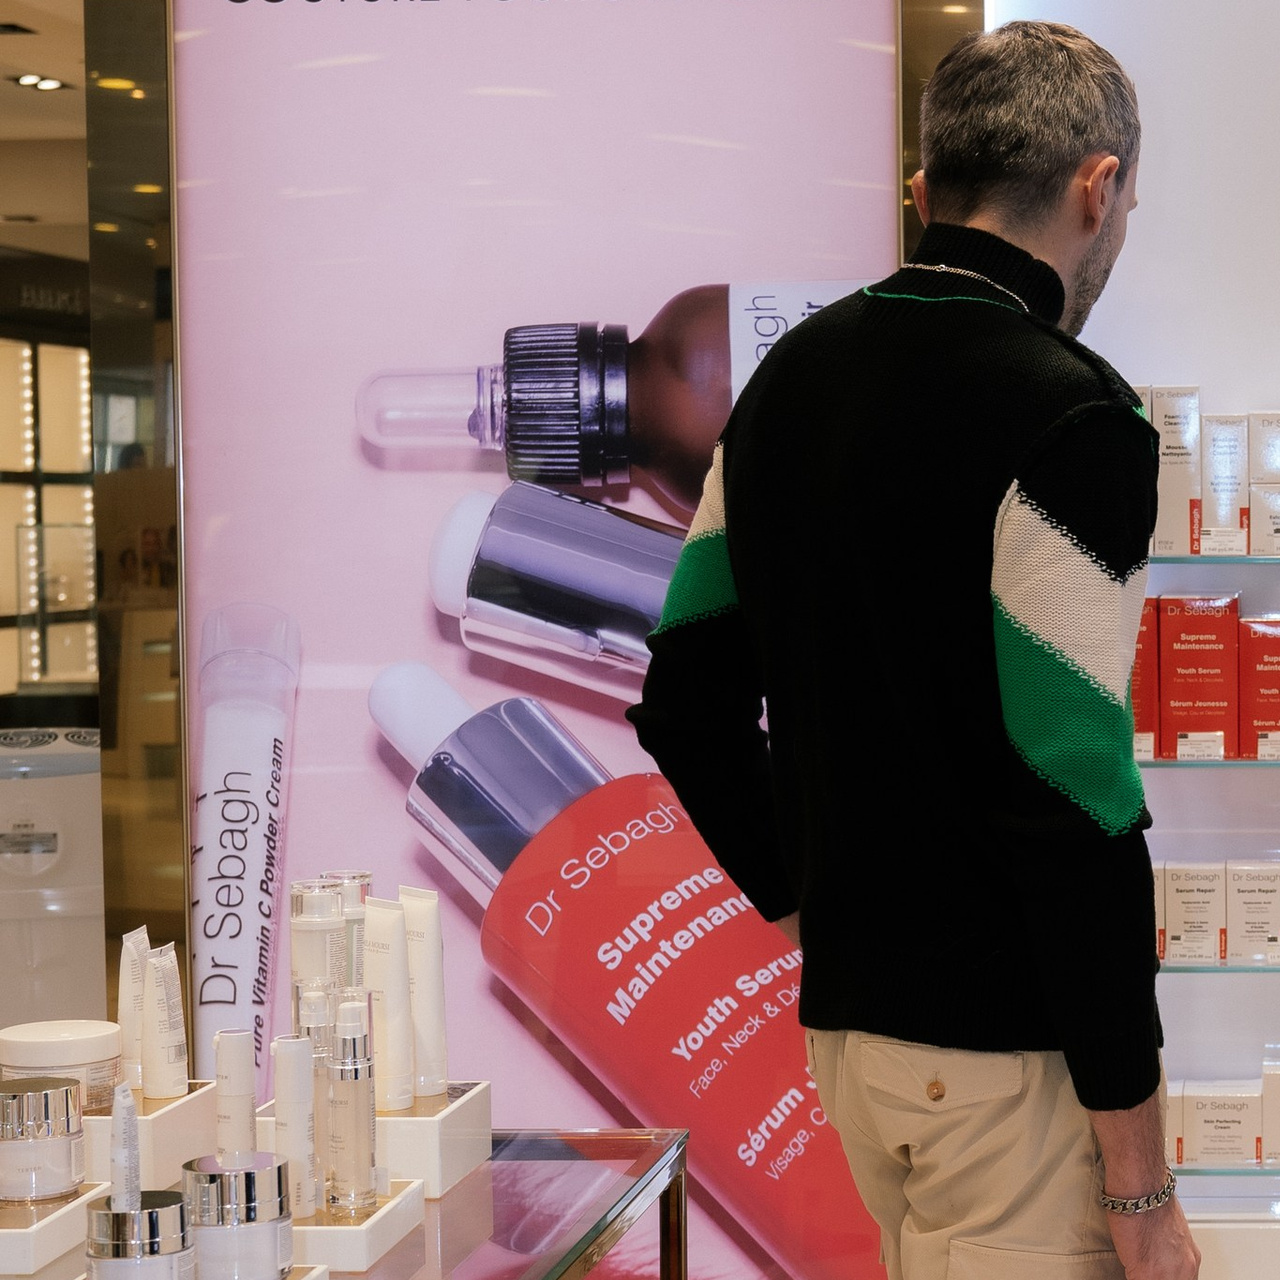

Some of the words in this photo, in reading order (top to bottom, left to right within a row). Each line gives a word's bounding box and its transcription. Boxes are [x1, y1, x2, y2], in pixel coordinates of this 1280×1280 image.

[744, 295, 788, 362] agh
[1167, 607, 1181, 616] Dr
[1183, 606, 1230, 618] Sebagh
[1180, 633, 1216, 642] Supreme
[265, 737, 284, 809] Cream
[203, 770, 260, 939] Sebagh
[260, 812, 279, 897] Powder
[525, 889, 562, 937] Dr
[560, 802, 689, 890] Sebagh
[1185, 873, 1220, 882] Sebagh
[1246, 873, 1280, 883] Sebagh
[257, 901, 273, 921] C
[597, 867, 724, 971] Supreme
[199, 956, 239, 1006] Dr
[252, 924, 271, 1008] Vitamin
[606, 891, 755, 1026] Maintenan
[671, 994, 739, 1062] Youth
[689, 1059, 729, 1099] Face,
[721, 1014, 766, 1056] Neck
[763, 1001, 782, 1018] &
[737, 1087, 805, 1168] Sérum
[1196, 1102, 1207, 1110] Dr
[1210, 1102, 1248, 1112] Sebagh
[765, 1129, 816, 1181] Visage,
